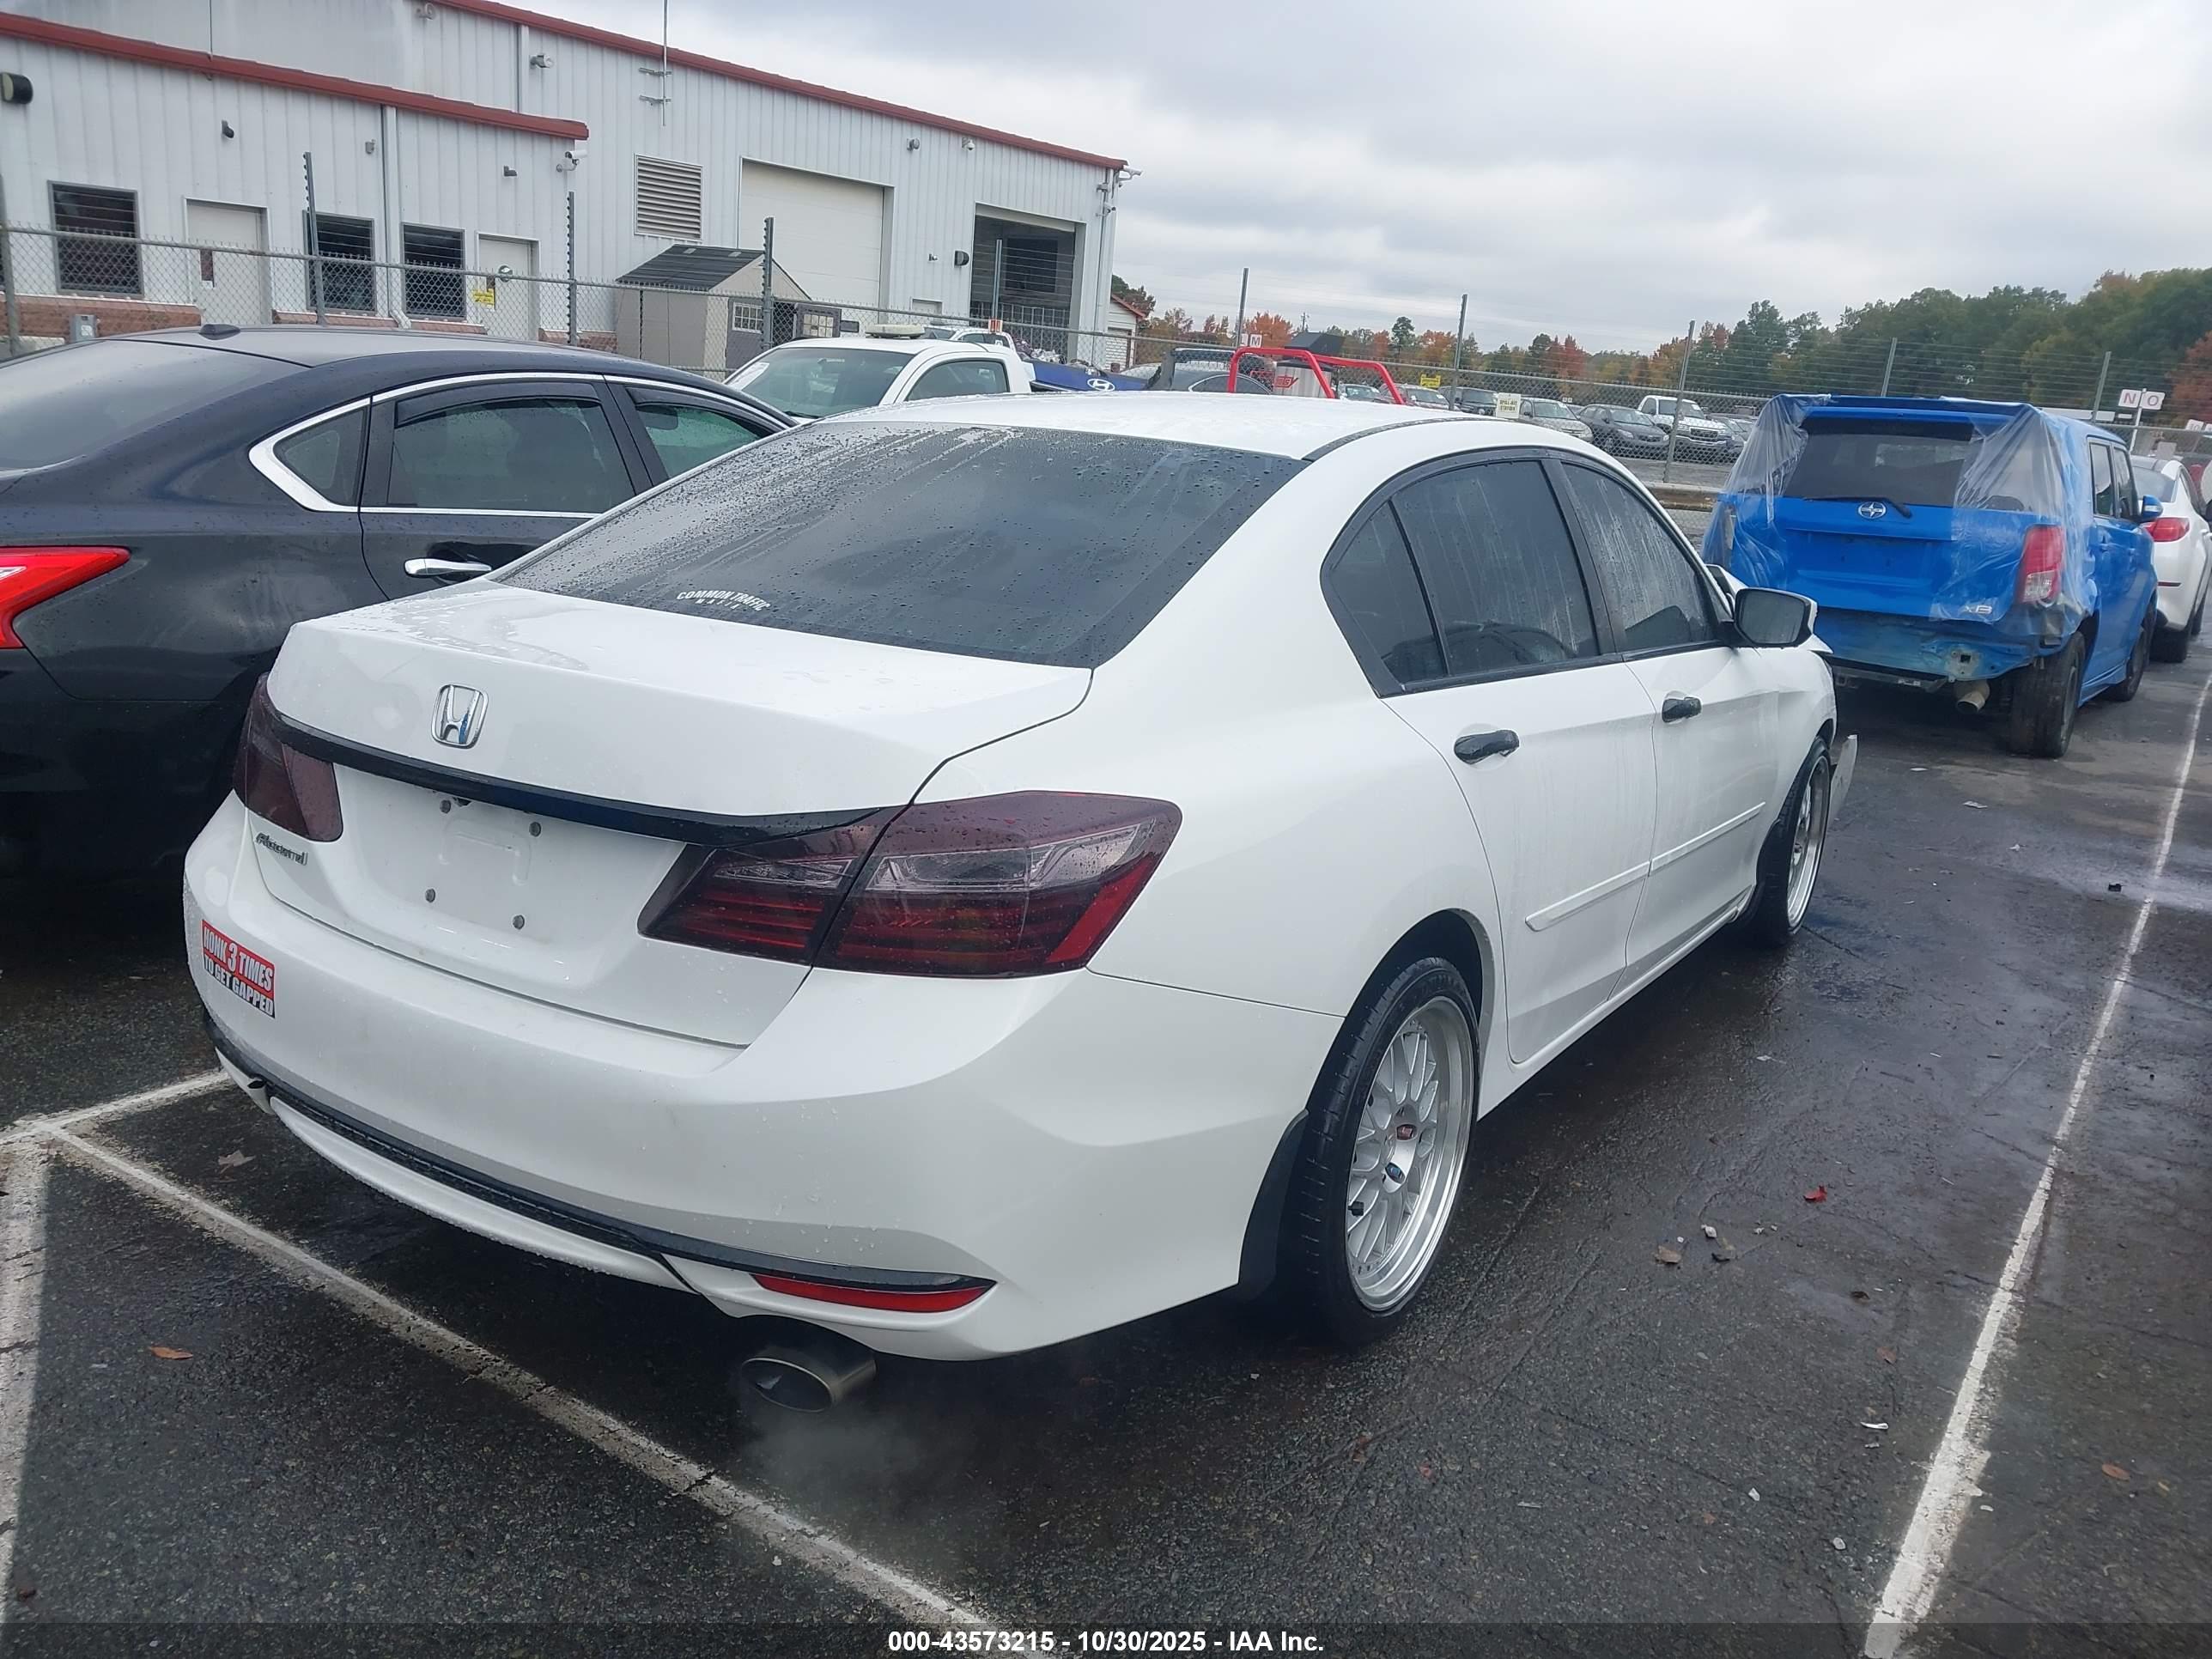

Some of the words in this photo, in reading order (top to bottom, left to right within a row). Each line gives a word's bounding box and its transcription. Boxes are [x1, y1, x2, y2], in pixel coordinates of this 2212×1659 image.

[677, 590, 735, 600] COMMON
[729, 592, 771, 611] TRAFFIC
[204, 927, 228, 963] HONK
[228, 942, 238, 972] 3
[239, 951, 273, 992] TIMES
[204, 954, 214, 975] TO
[215, 963, 232, 988] GET
[232, 976, 273, 1016] GAPPED
